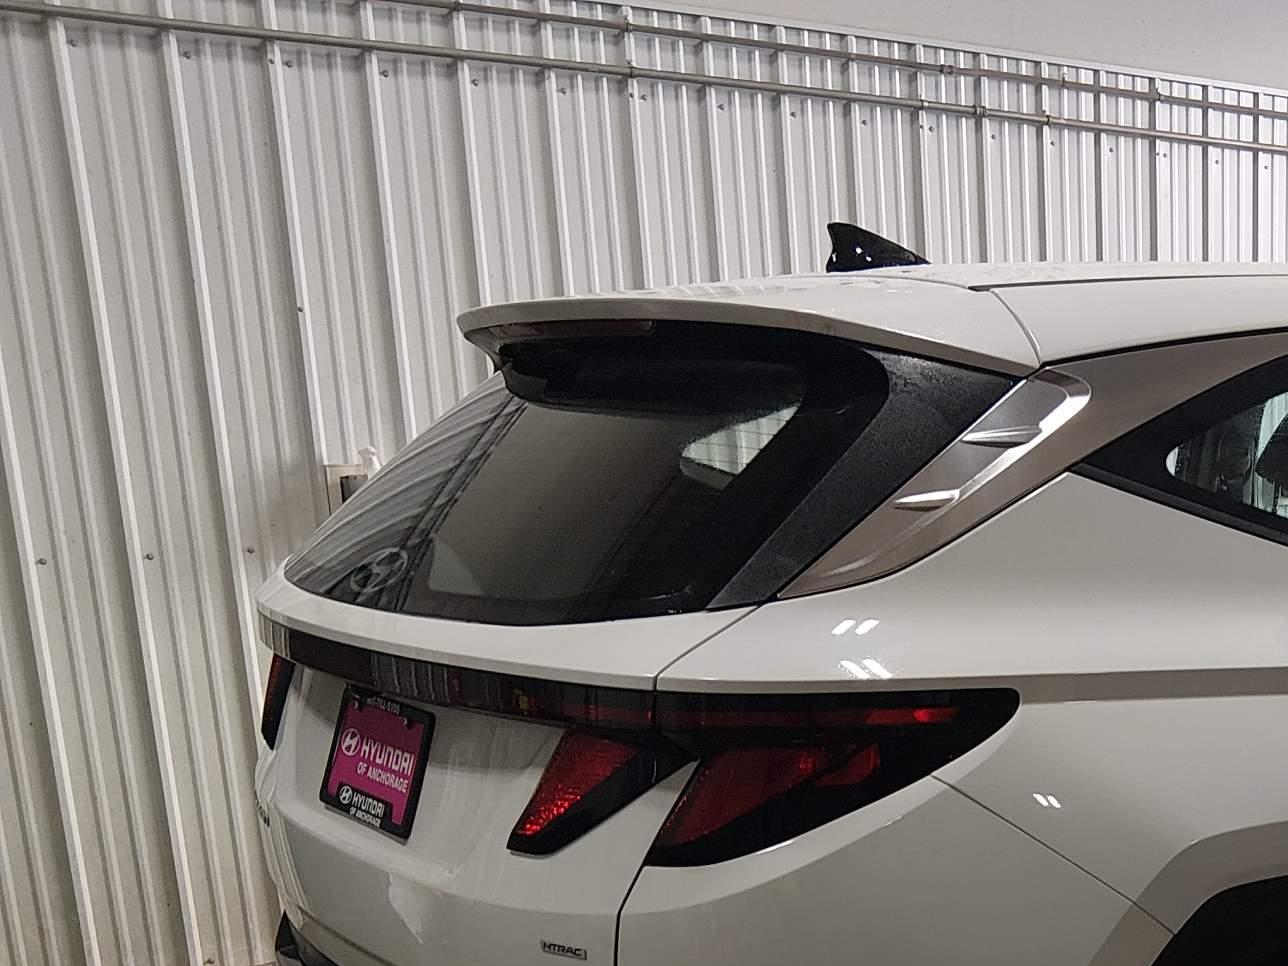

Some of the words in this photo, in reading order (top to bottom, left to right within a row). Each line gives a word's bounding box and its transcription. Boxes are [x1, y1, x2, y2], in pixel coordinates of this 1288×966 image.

[360, 736, 415, 776] HYUNDAI
[357, 761, 368, 775] OF
[366, 765, 409, 793] ANCHORAGE
[351, 791, 385, 818] HYUNDAI
[543, 941, 583, 957] HTRAC
